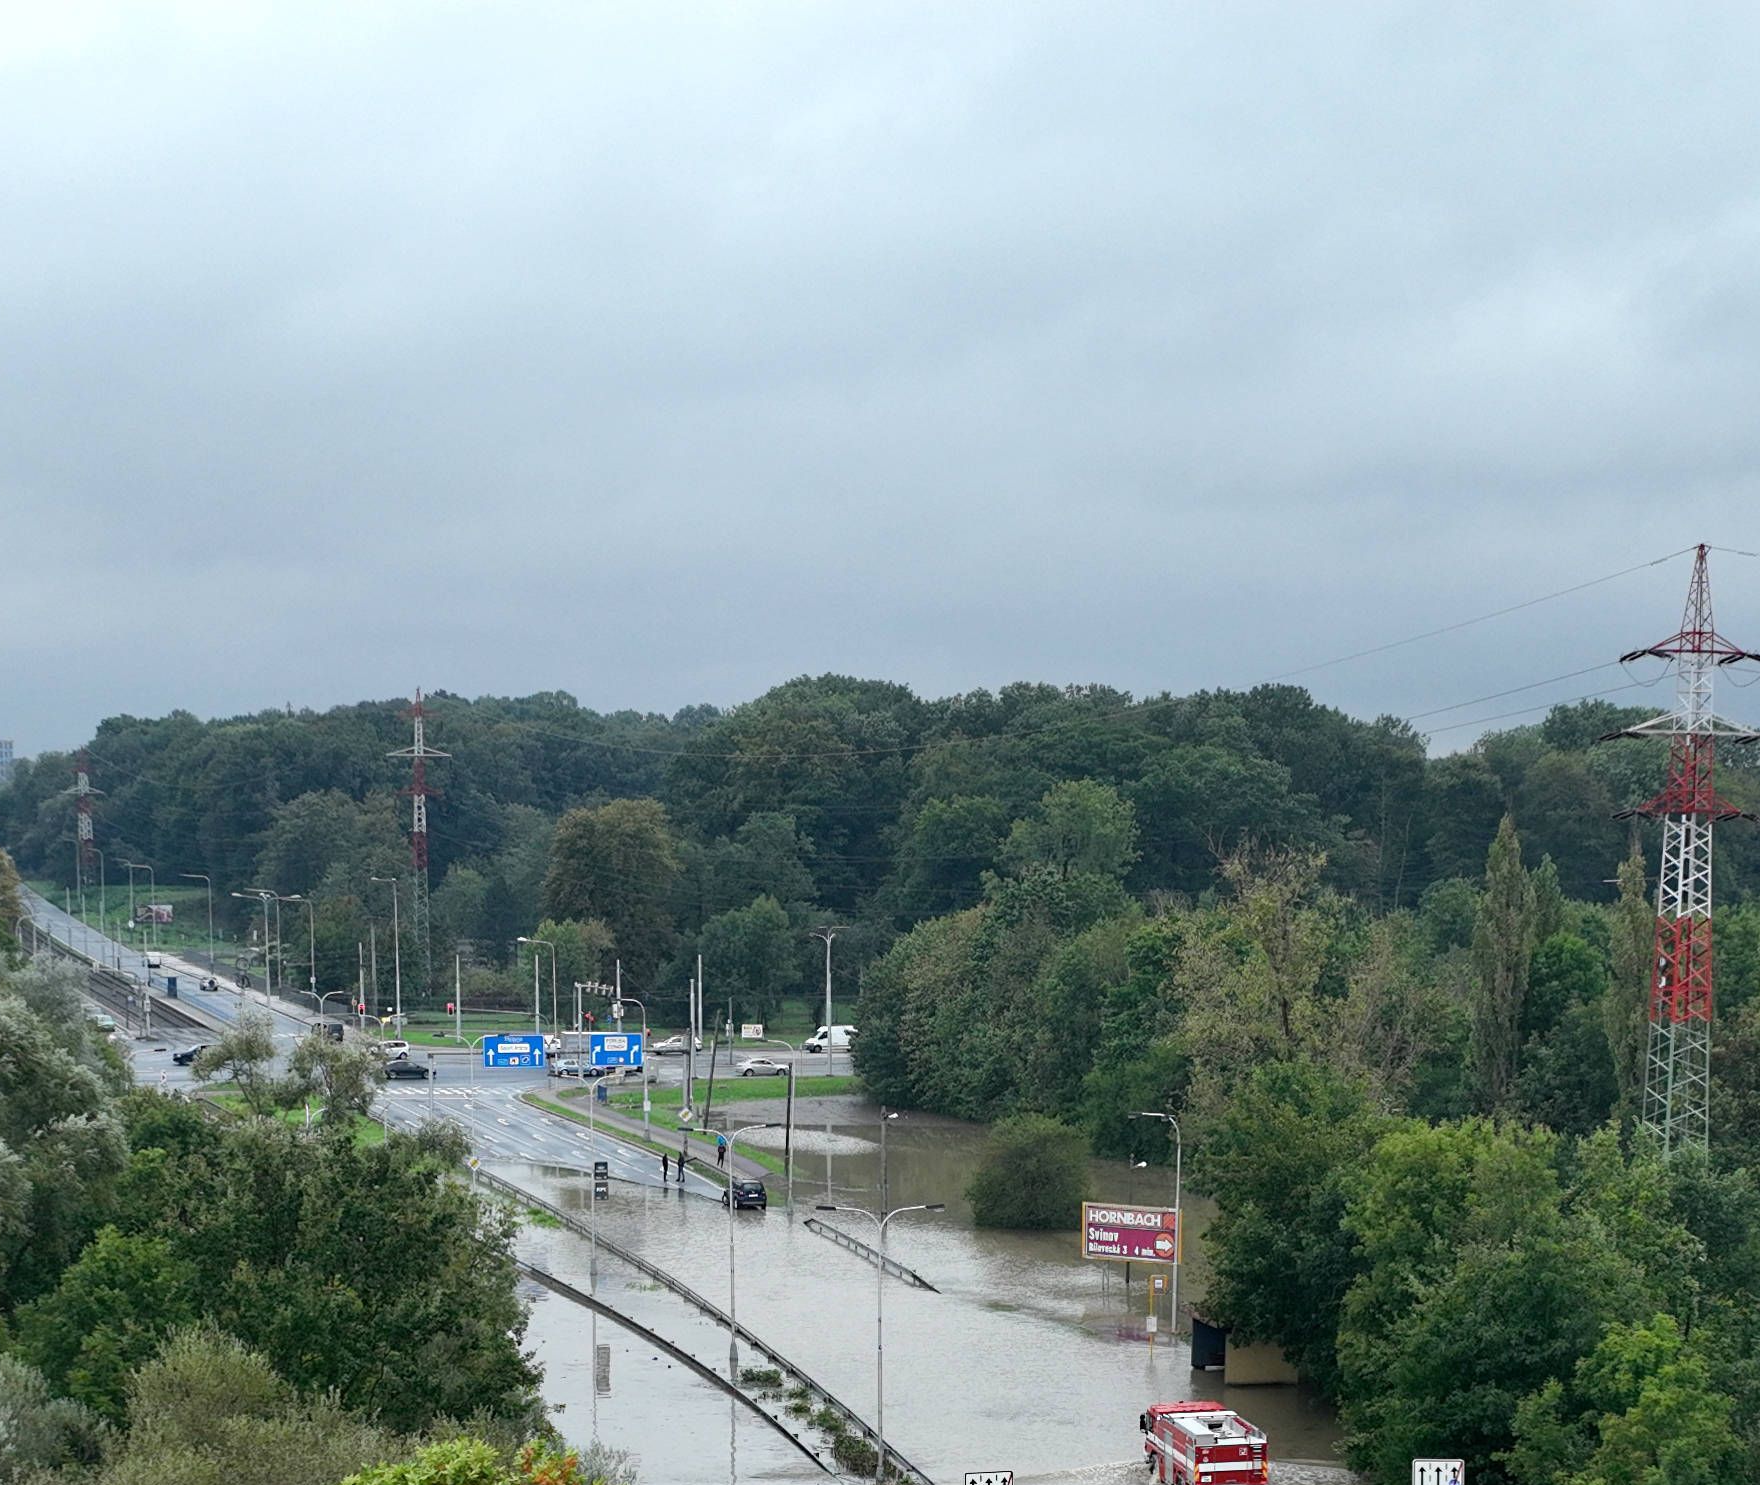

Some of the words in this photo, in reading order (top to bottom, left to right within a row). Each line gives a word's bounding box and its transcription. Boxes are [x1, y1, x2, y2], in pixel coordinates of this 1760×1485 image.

[1089, 1210, 1161, 1226] HORNBACH
[1088, 1227, 1119, 1241] Svinov
[1134, 1246, 1139, 1255] 4
